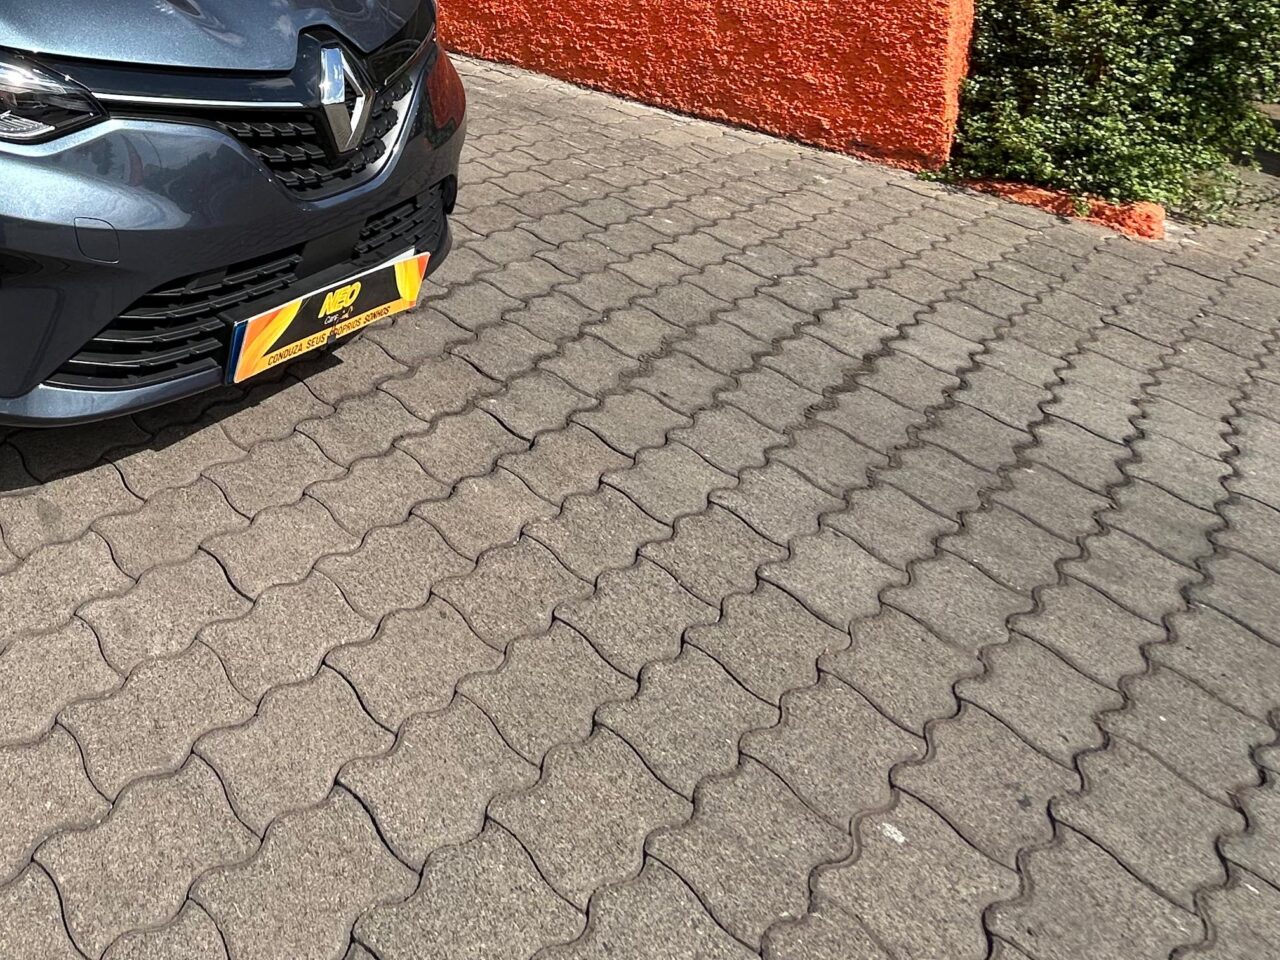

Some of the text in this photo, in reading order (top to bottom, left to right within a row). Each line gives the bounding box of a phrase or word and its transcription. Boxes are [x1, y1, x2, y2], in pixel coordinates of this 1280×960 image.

[318, 282, 361, 318] NEO
[268, 343, 303, 366] CONDUZA
[306, 334, 327, 350] SEUS
[363, 305, 391, 324] SONHOS
